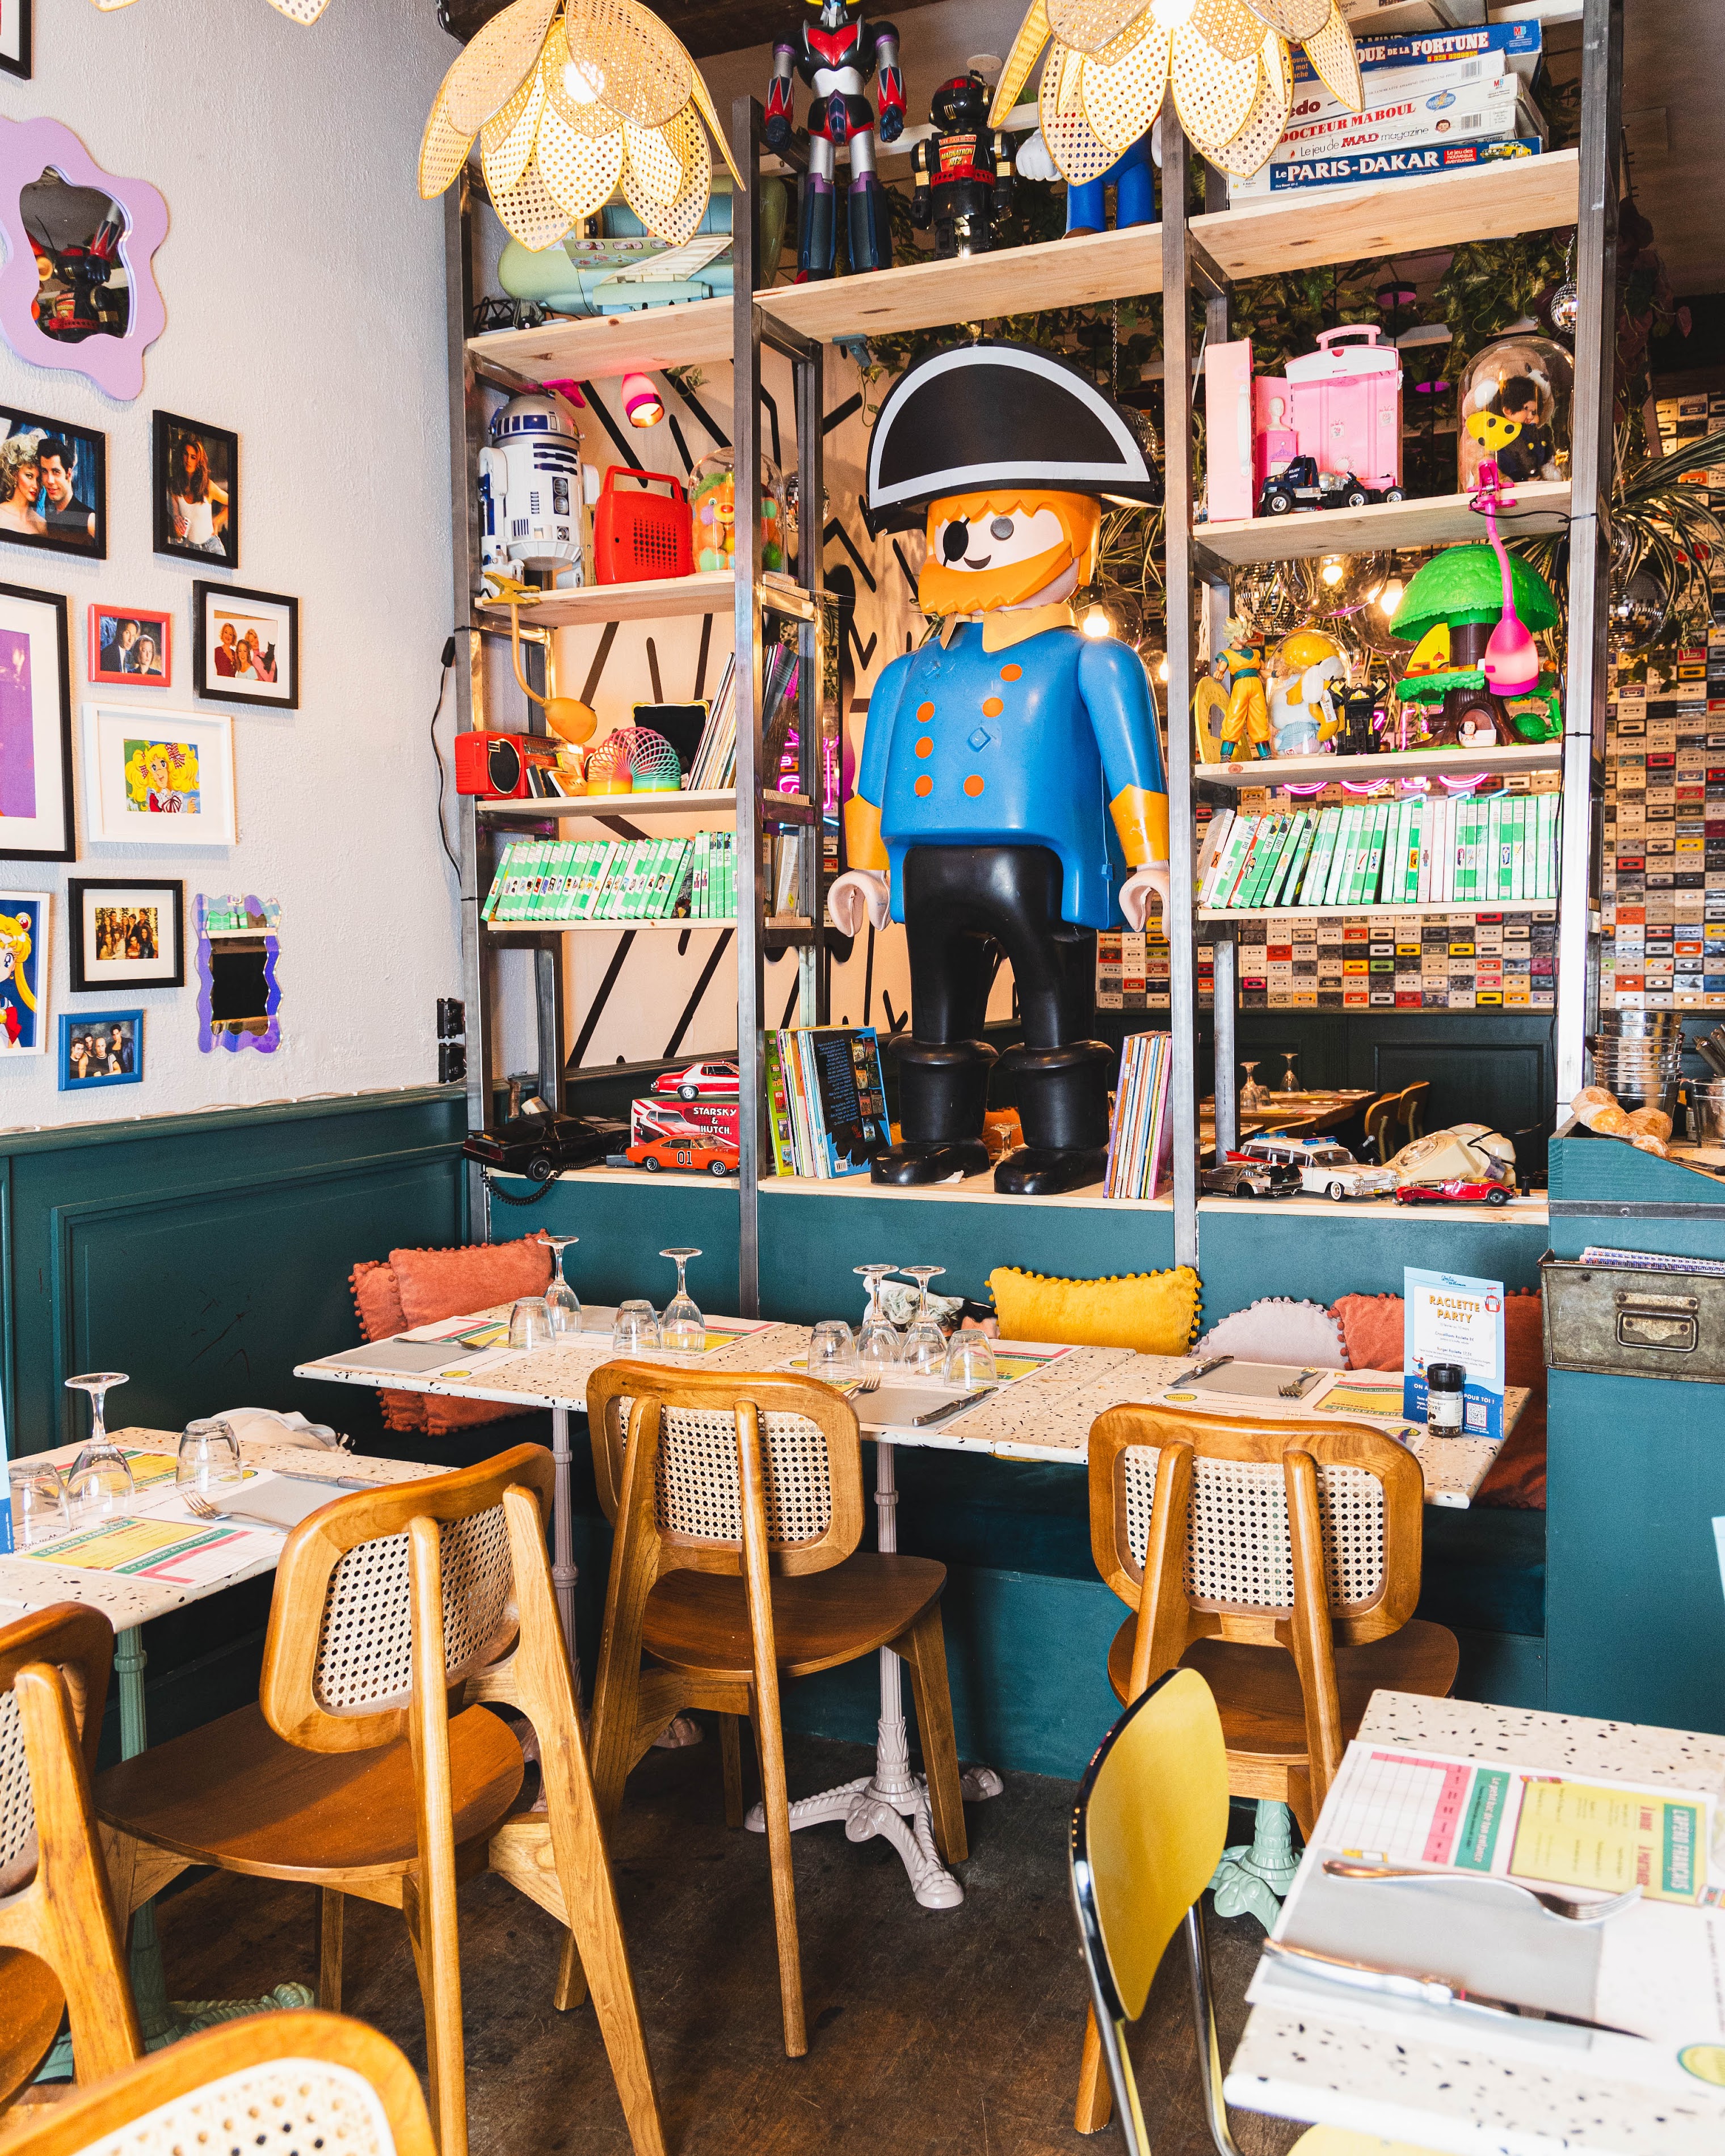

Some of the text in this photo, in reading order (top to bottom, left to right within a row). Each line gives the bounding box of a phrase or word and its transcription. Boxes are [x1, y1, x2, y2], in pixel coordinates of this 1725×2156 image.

[1513, 26, 1526, 36] MB
[1412, 32, 1490, 56] FORTUNE
[1493, 78, 1504, 87] MB
[1280, 103, 1416, 144] DOCTEUR MABOUL
[1301, 128, 1429, 158] Le jeu de MAD magazine
[941, 148, 973, 161] MAGNATRON
[1276, 151, 1440, 182] Le PARIS-DAKAR
[693, 1107, 737, 1117] STARSKY
[700, 1125, 730, 1134] HUTCH
[677, 1149, 693, 1165] 01
[1429, 1295, 1480, 1312] RACLETTE
[1437, 1309, 1472, 1323] PARTY
[1463, 1393, 1479, 1401] POUR
[1491, 1776, 1501, 1786] Le
[1486, 1784, 1501, 1800] petit
[1485, 1801, 1496, 1812] bac
[1483, 1813, 1493, 1821] de
[1480, 1821, 1491, 1834] ton
[1473, 1835, 1489, 1863] enfance
[1667, 1809, 1692, 1889] L'APÉRO FRANÇAIS
